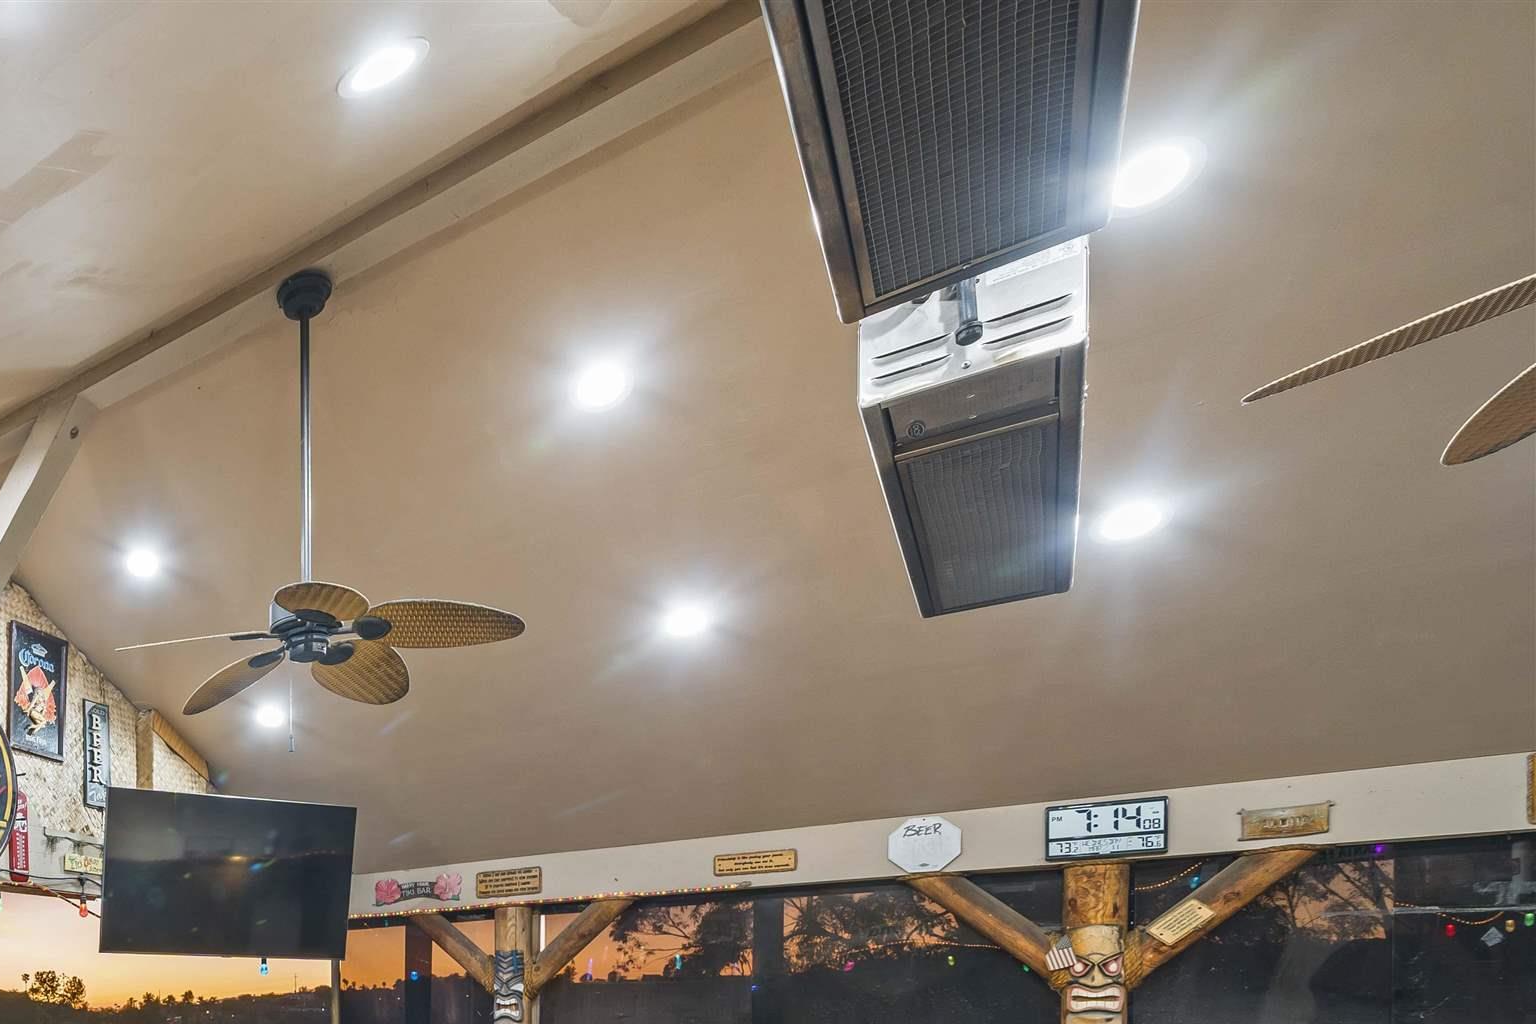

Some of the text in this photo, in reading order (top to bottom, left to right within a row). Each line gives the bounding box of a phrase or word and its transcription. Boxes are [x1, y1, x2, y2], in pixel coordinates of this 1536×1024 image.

[19, 648, 55, 673] Corona
[90, 714, 107, 786] BEER
[903, 822, 942, 838] BEER
[1075, 805, 1161, 833] 7:14 08
